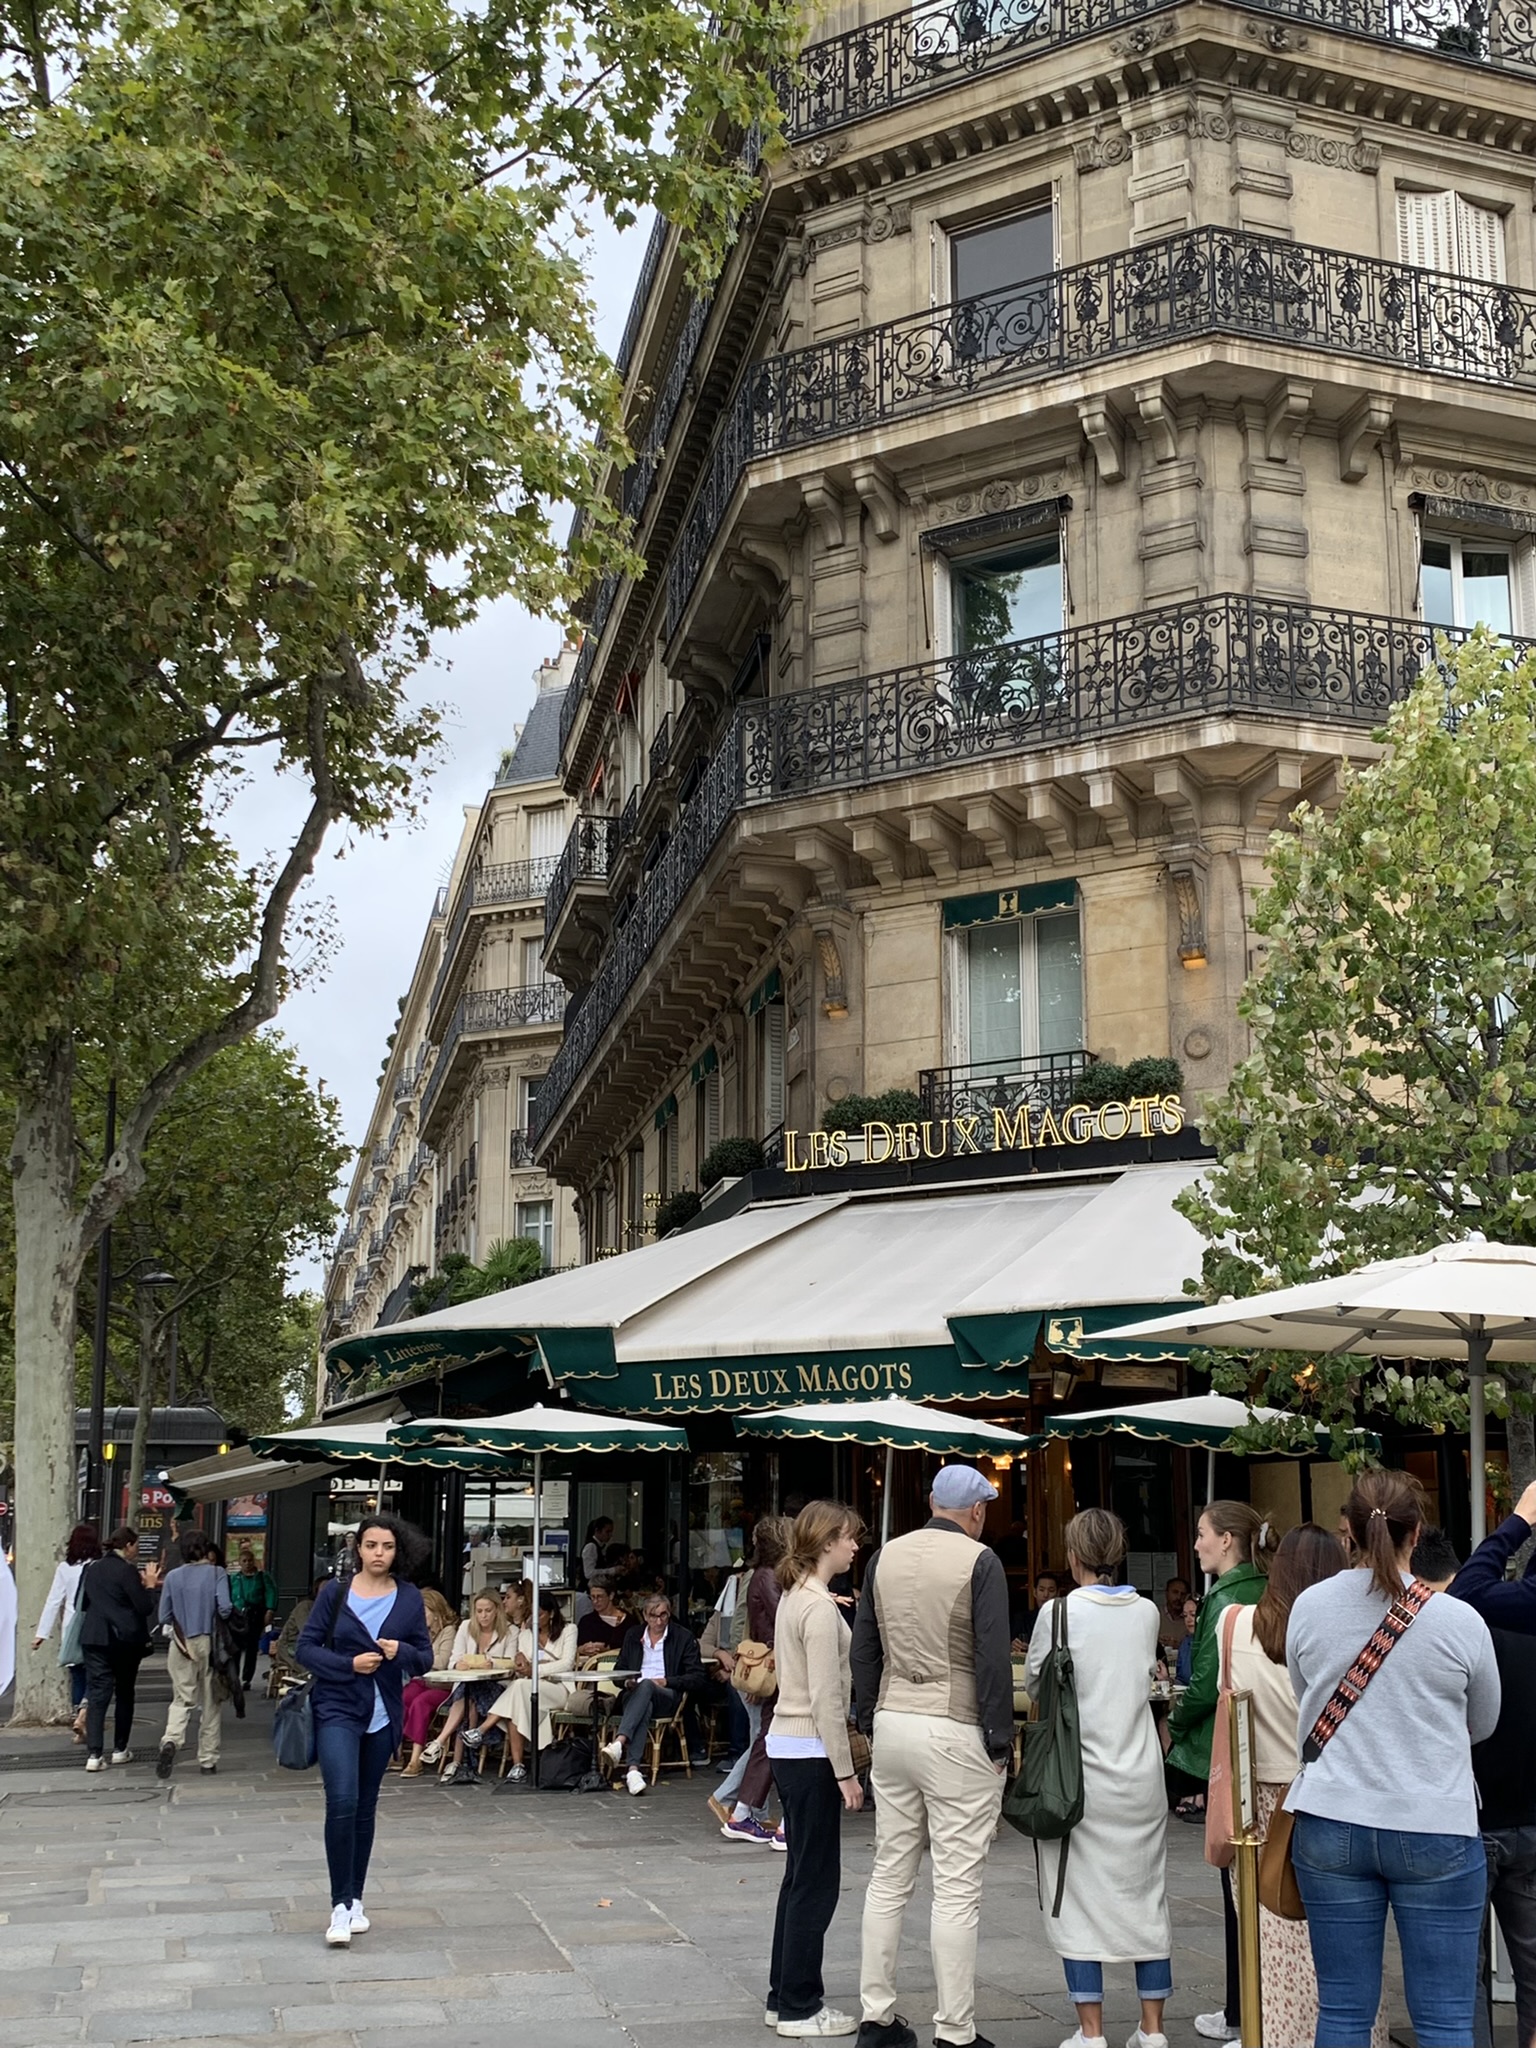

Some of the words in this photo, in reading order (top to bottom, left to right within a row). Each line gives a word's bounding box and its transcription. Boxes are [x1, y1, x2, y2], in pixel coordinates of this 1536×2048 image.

[784, 1130, 848, 1172] LES
[861, 1117, 980, 1165] DEUX
[991, 1093, 1186, 1152] MAGOTS
[652, 1372, 702, 1400] LES
[708, 1368, 791, 1398] DEUX
[796, 1362, 913, 1393] MAGOTS
[152, 1490, 176, 1504] Po
[139, 1514, 163, 1528] ins
